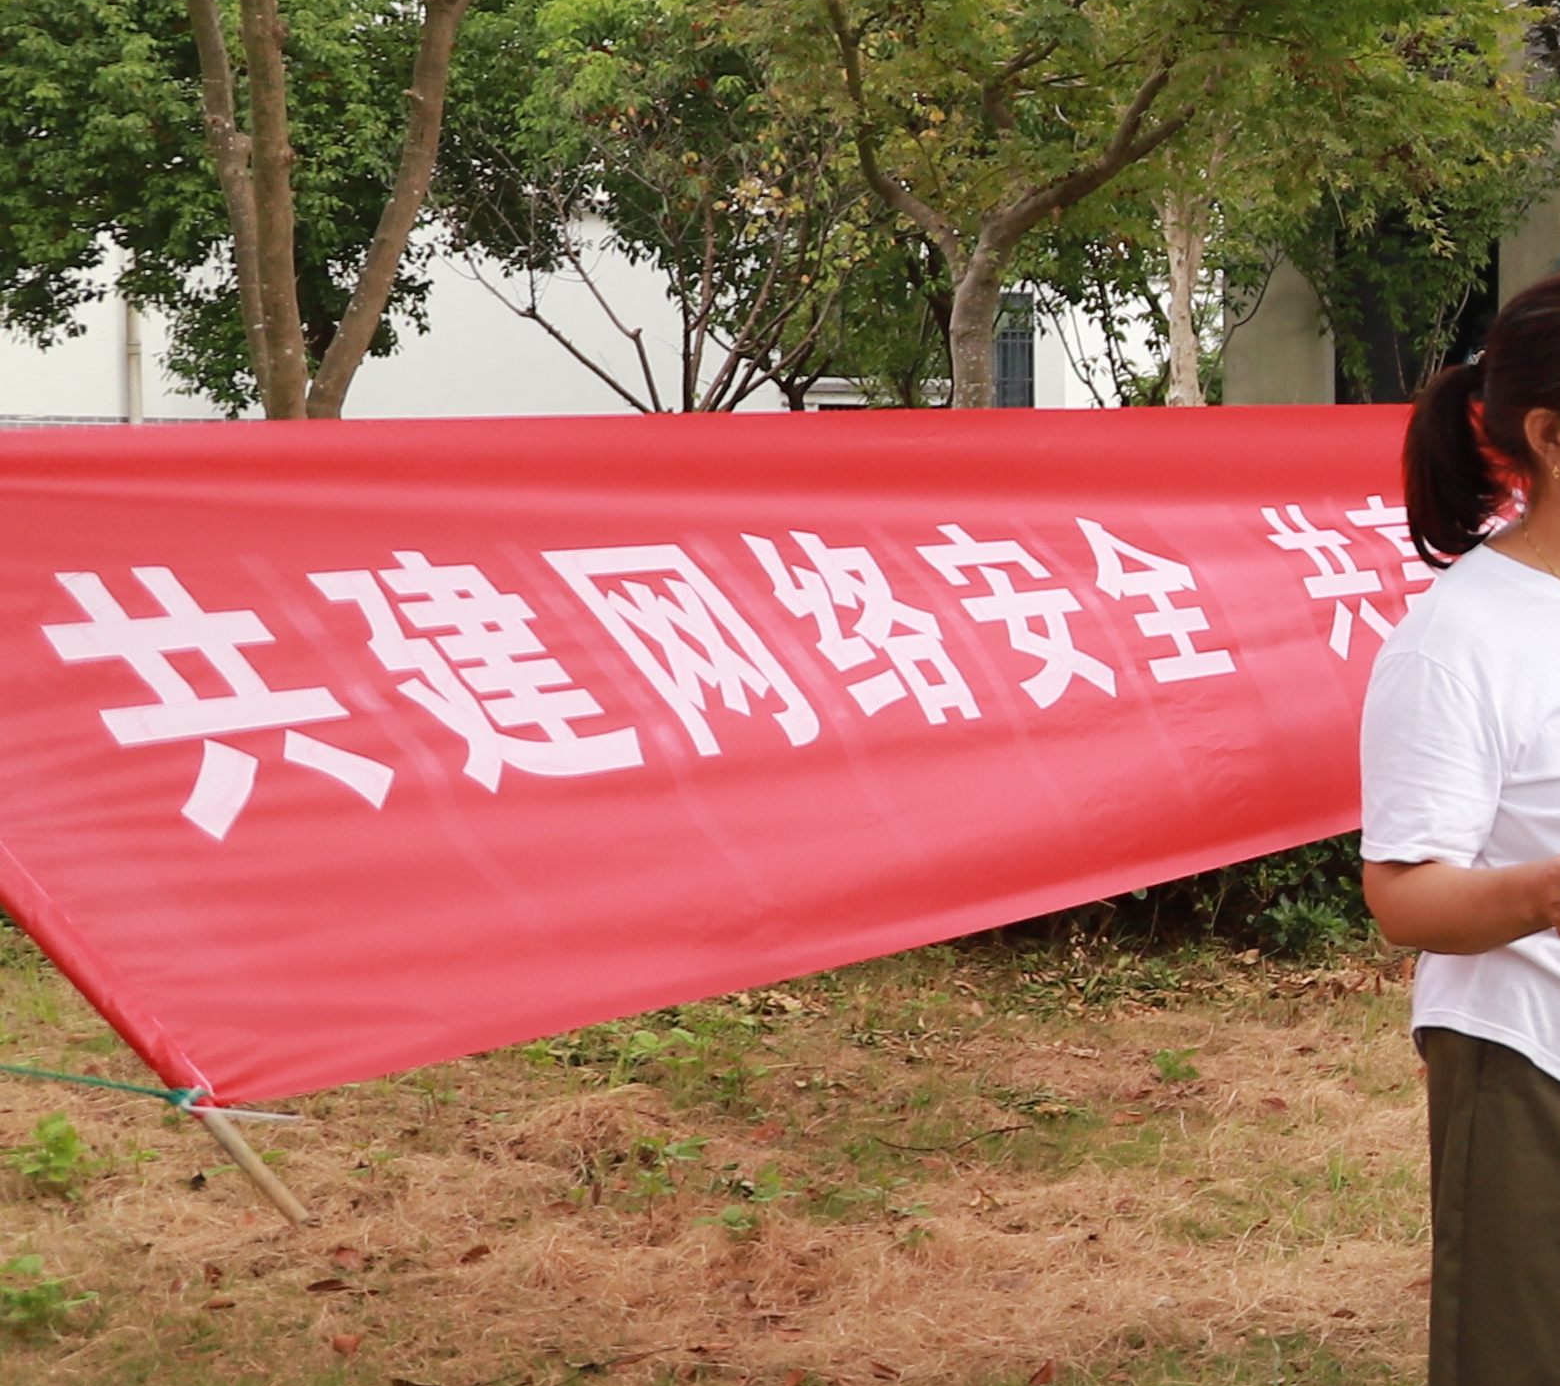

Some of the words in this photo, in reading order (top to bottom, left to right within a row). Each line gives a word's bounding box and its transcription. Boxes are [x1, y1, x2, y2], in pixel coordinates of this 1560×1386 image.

[41, 517, 1237, 842] 共建网络安全
